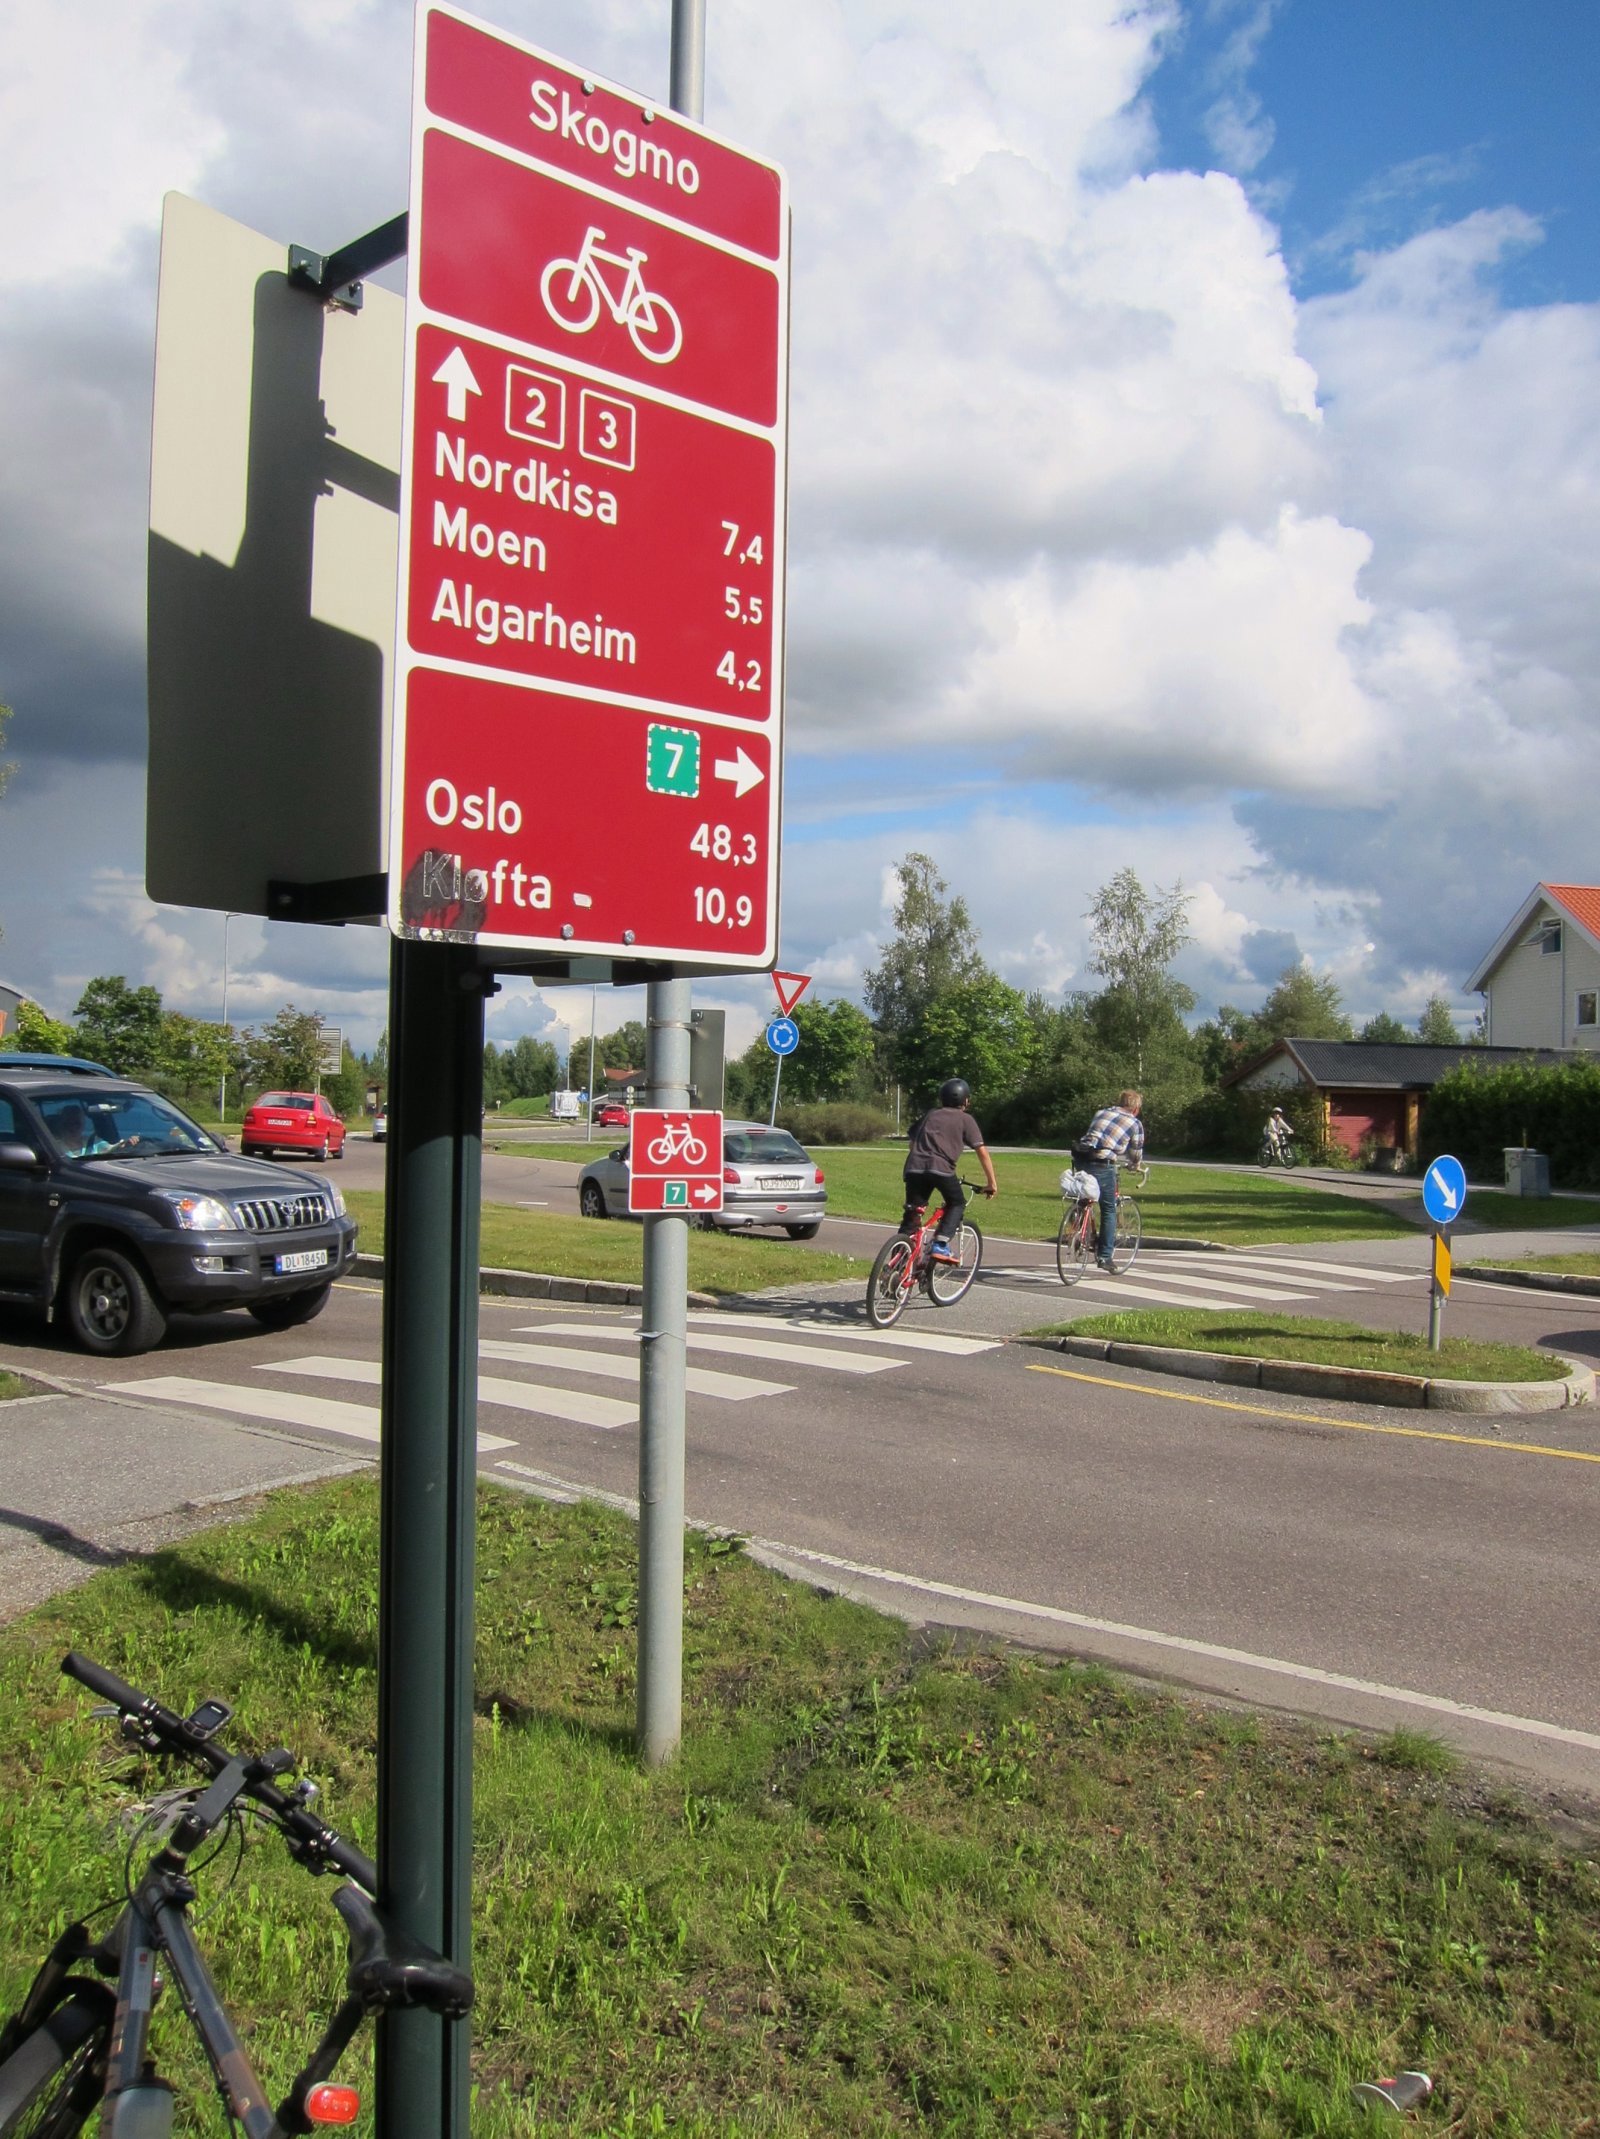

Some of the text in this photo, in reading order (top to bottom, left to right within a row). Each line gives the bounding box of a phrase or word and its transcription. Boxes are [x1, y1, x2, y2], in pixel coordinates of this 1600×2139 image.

[529, 79, 700, 194] Skogmo
[525, 388, 618, 450] 2 3
[434, 431, 619, 526] Nordkisa
[432, 500, 548, 573] Moen
[721, 520, 764, 565] 7,4
[431, 578, 637, 665] Algarheim
[724, 586, 763, 625] 5,5
[716, 650, 762, 692] 4,2
[664, 742, 684, 779] 7
[425, 778, 522, 835] Oslo
[689, 822, 757, 867] 48,3
[422, 850, 552, 910] Kløfta
[694, 886, 753, 929] 10,9
[671, 1186, 681, 1201] 7
